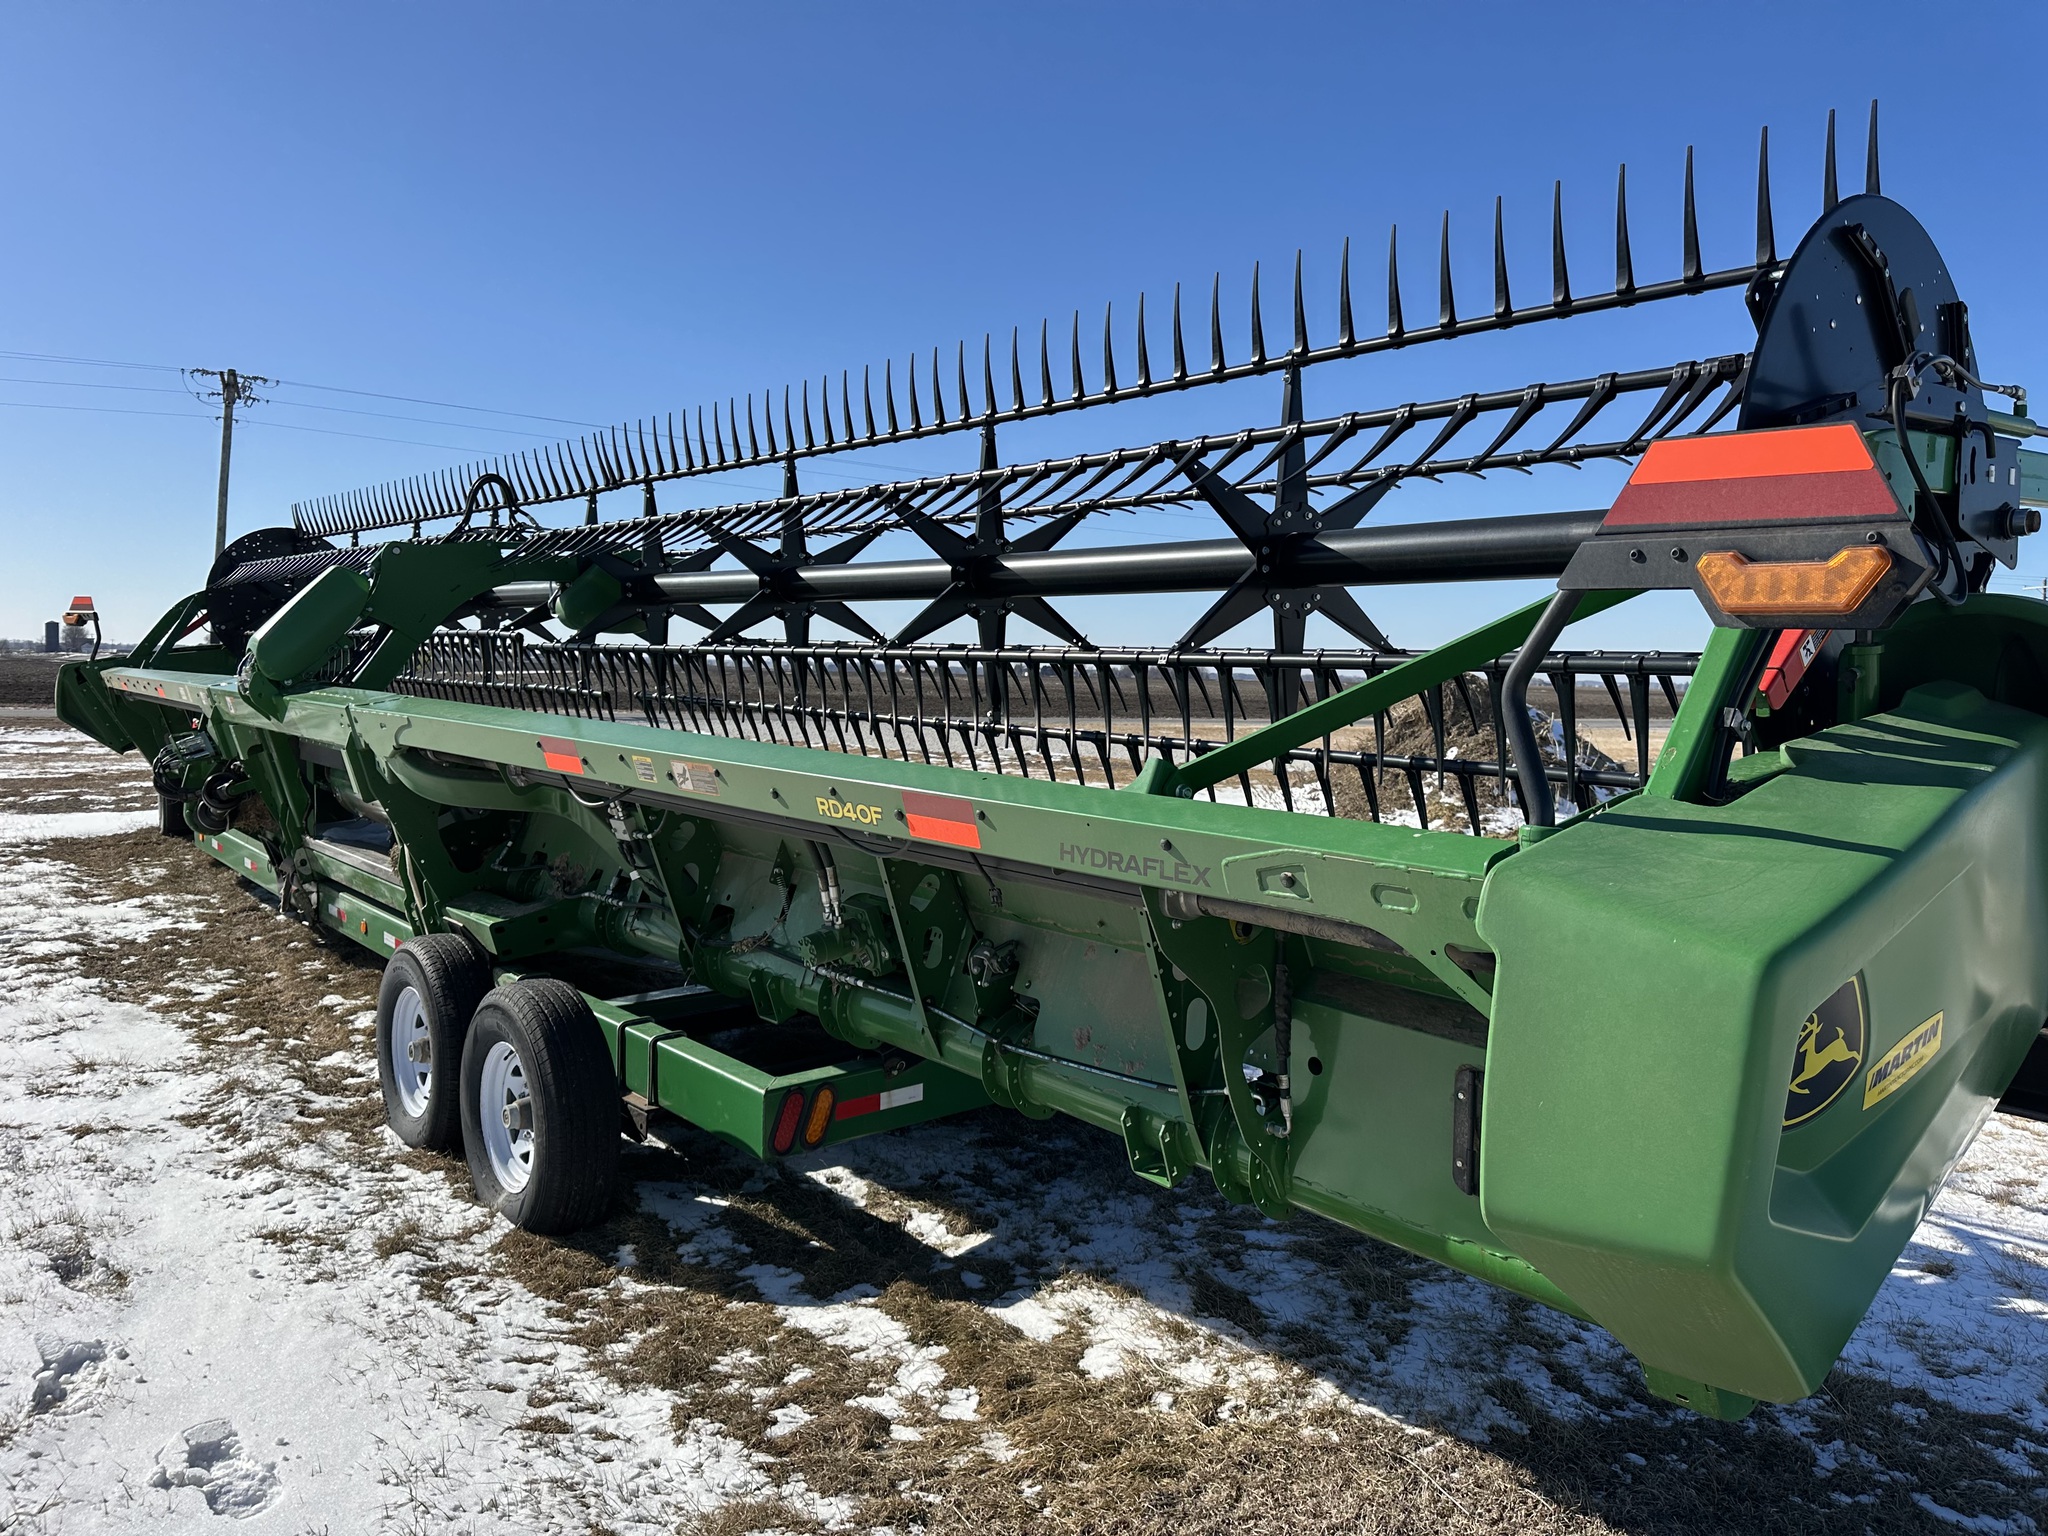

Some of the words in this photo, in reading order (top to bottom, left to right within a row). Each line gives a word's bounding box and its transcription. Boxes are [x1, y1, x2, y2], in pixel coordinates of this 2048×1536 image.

[815, 796, 882, 826] RD40F
[1059, 842, 1211, 888] HYDRAFLEX
[1868, 1017, 1941, 1092] MARTIN
